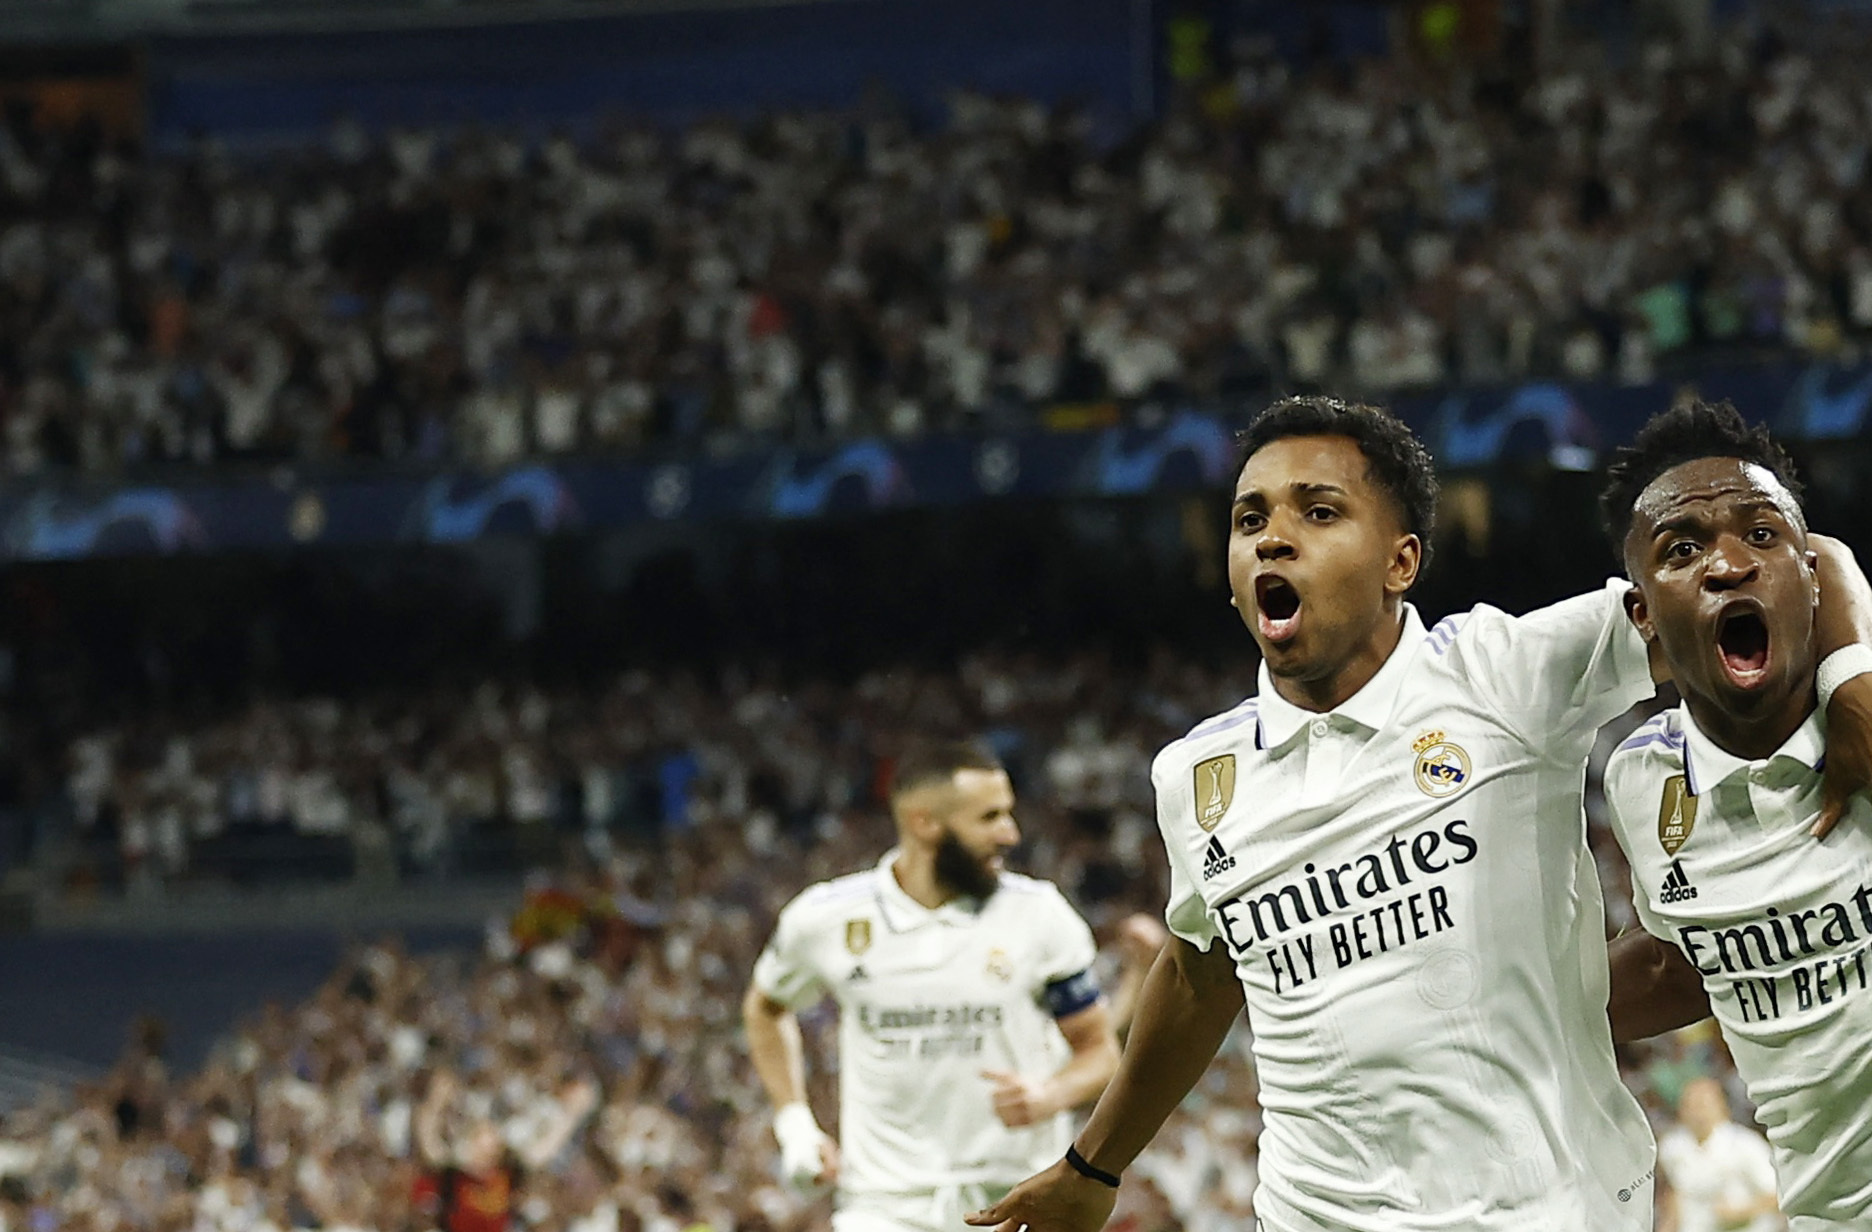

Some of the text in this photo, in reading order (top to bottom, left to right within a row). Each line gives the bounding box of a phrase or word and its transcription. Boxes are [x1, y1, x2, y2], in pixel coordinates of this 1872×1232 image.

[1665, 825, 1684, 837] FIFA
[1203, 856, 1236, 881] adidas
[1217, 820, 1478, 954] Emirates
[1660, 886, 1698, 904] adidas
[1267, 885, 1454, 993] FLY BETTER
[1734, 976, 1780, 1022] FLY
